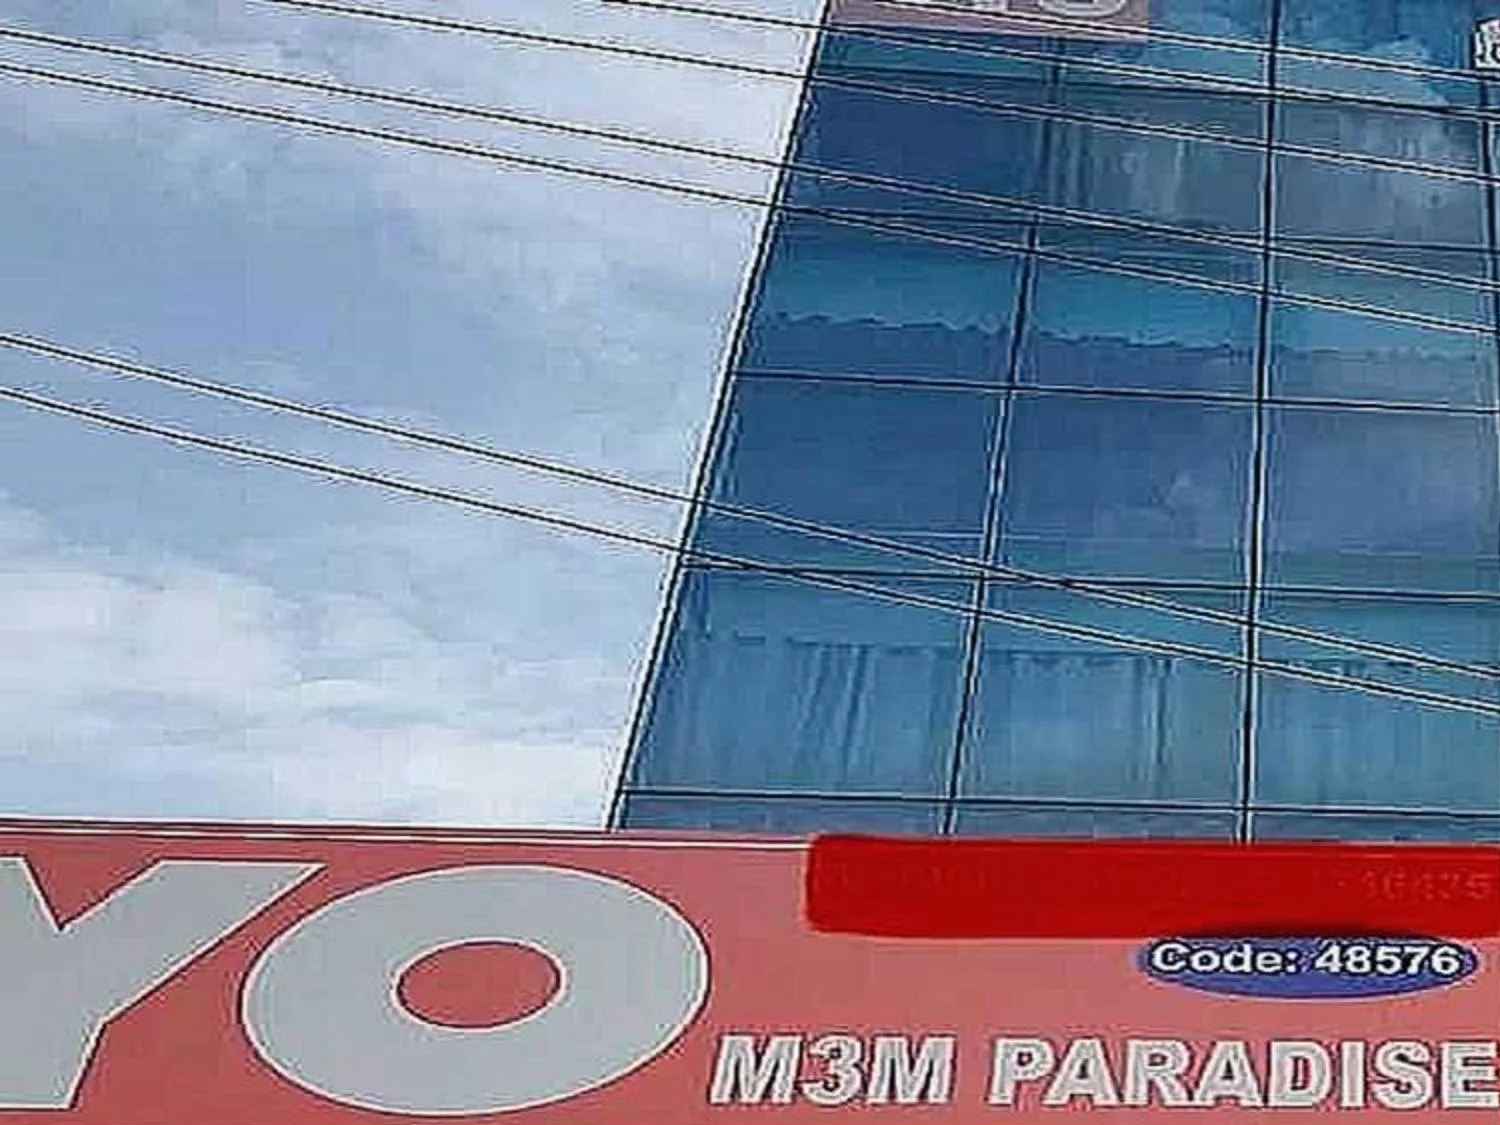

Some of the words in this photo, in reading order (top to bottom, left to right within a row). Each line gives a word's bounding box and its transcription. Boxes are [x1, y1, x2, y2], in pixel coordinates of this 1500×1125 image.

[1151, 941, 1298, 975] Code:
[1314, 943, 1461, 976] 48576
[709, 1034, 955, 1105] M3M
